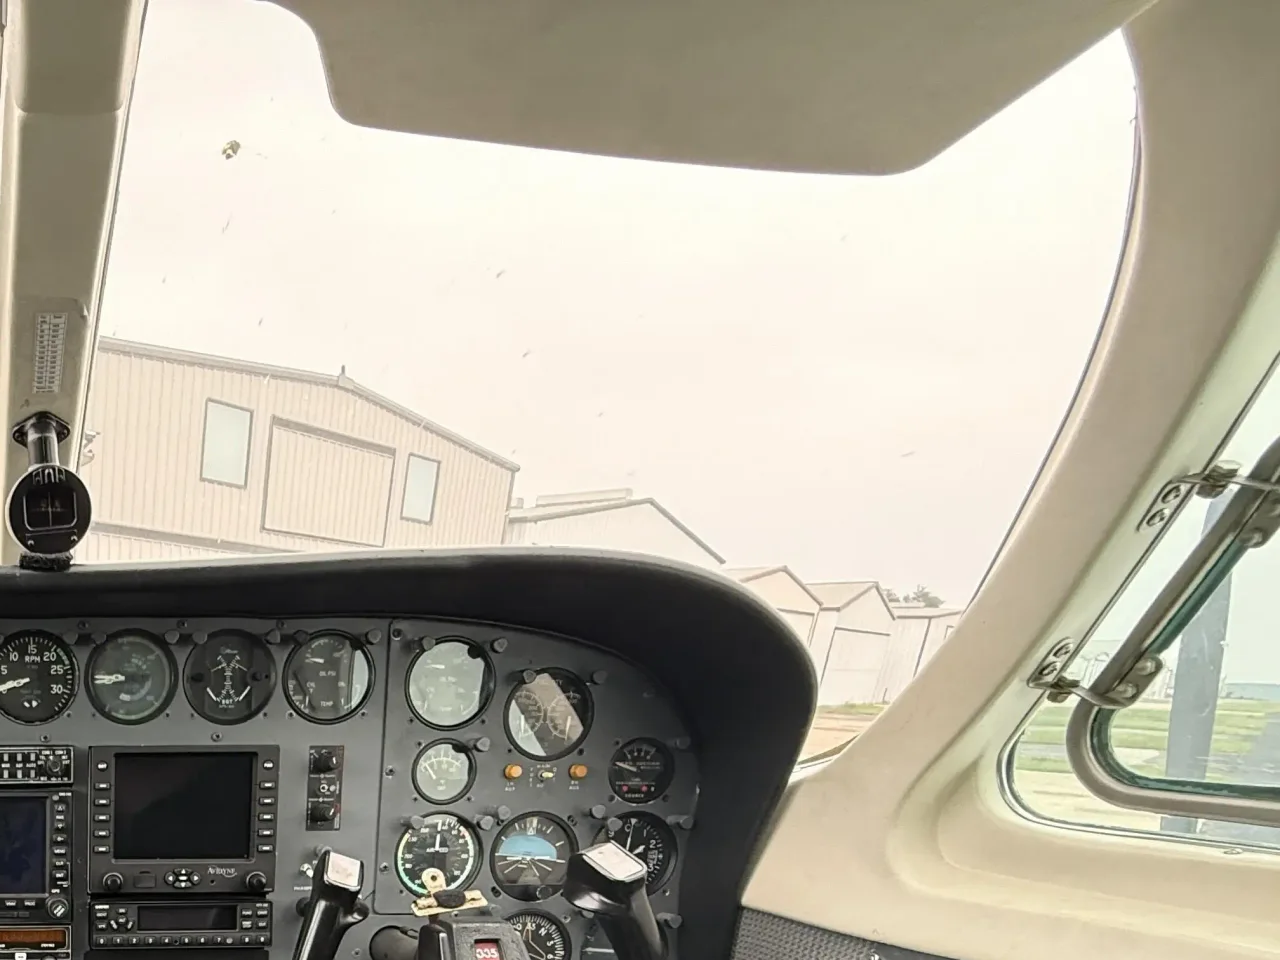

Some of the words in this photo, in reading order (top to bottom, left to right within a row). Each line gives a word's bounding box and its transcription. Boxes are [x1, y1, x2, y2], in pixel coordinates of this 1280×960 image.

[24, 655, 41, 663] RPM
[43, 652, 57, 662] 20
[50, 665, 64, 675] 25
[50, 685, 63, 694] 30
